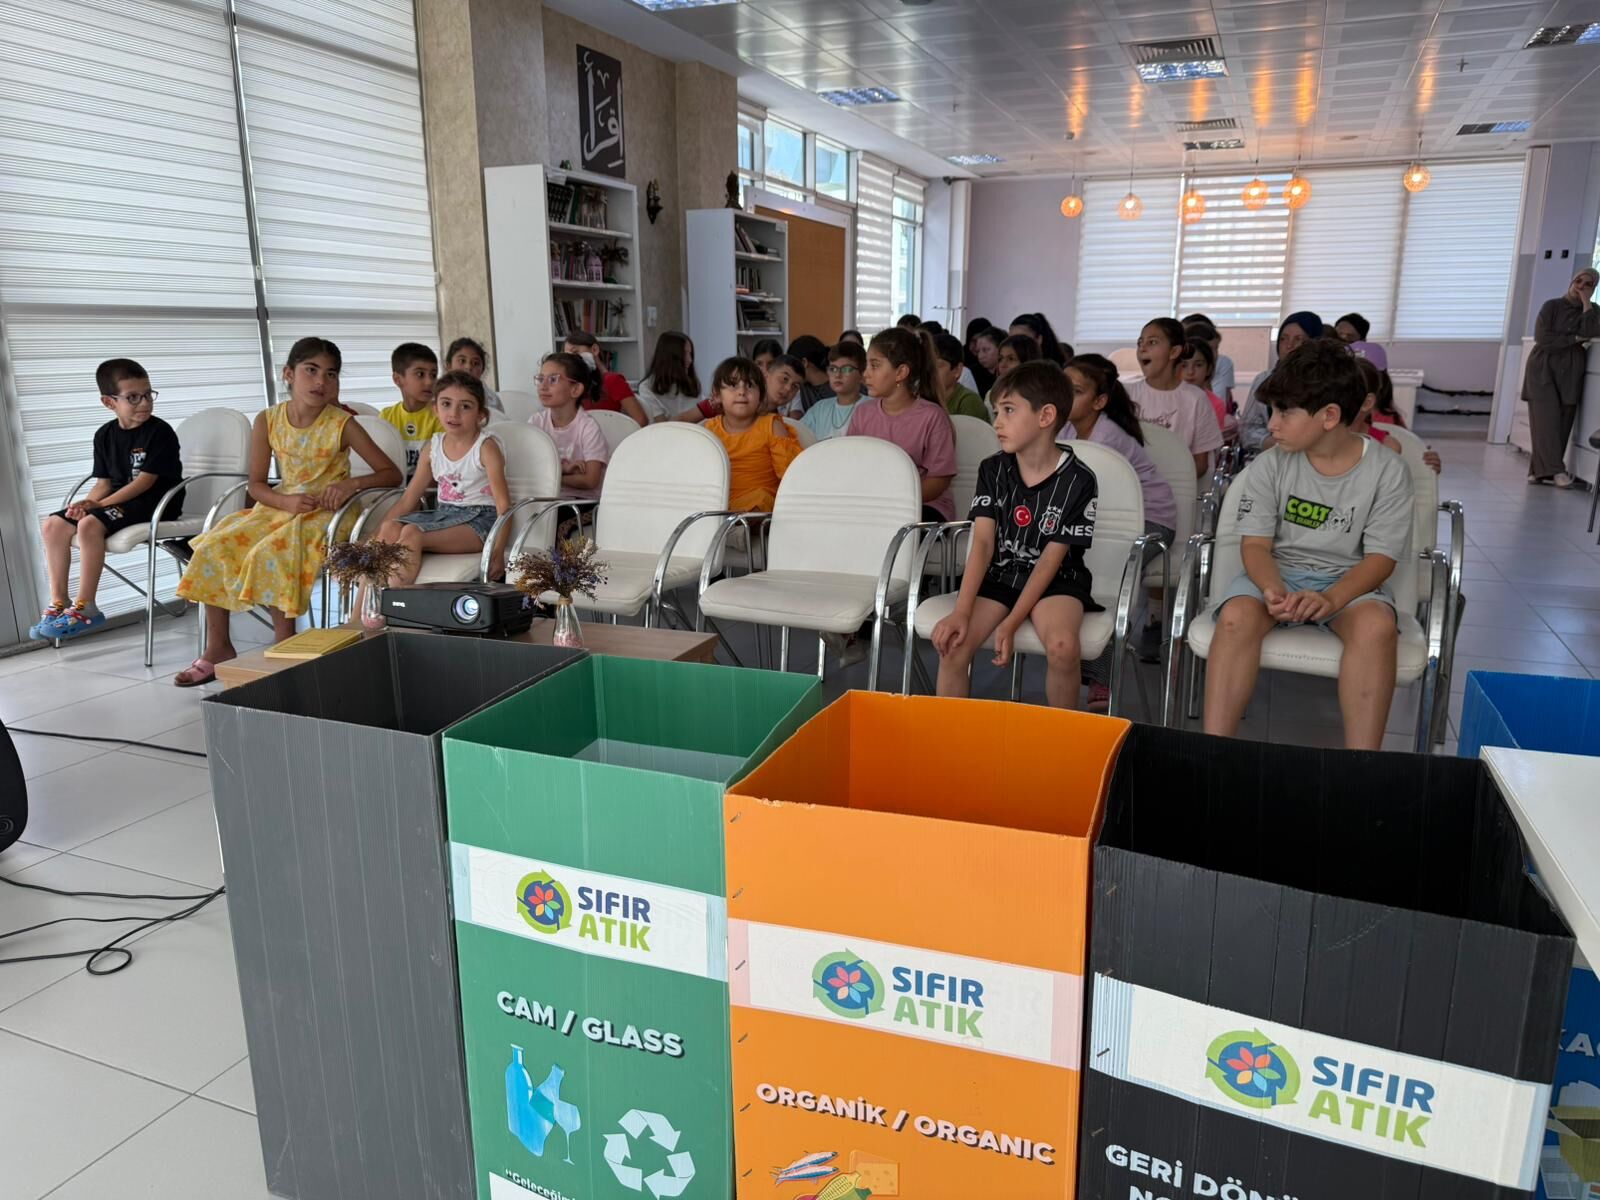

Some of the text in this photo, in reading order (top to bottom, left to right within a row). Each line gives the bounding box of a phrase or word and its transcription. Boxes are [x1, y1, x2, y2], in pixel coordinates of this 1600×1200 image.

[577, 886, 650, 923] SIFIR
[578, 914, 650, 951] ATIK
[892, 966, 984, 1007] SIFIR
[497, 990, 684, 1057] CAM / GLASS
[893, 996, 984, 1038] ATIK
[1312, 1056, 1435, 1113] SIFIR
[756, 1082, 1056, 1164] ORGANİK / ORGANIC
[1308, 1095, 1432, 1148] ATIK
[1105, 1144, 1183, 1188] GERİ
